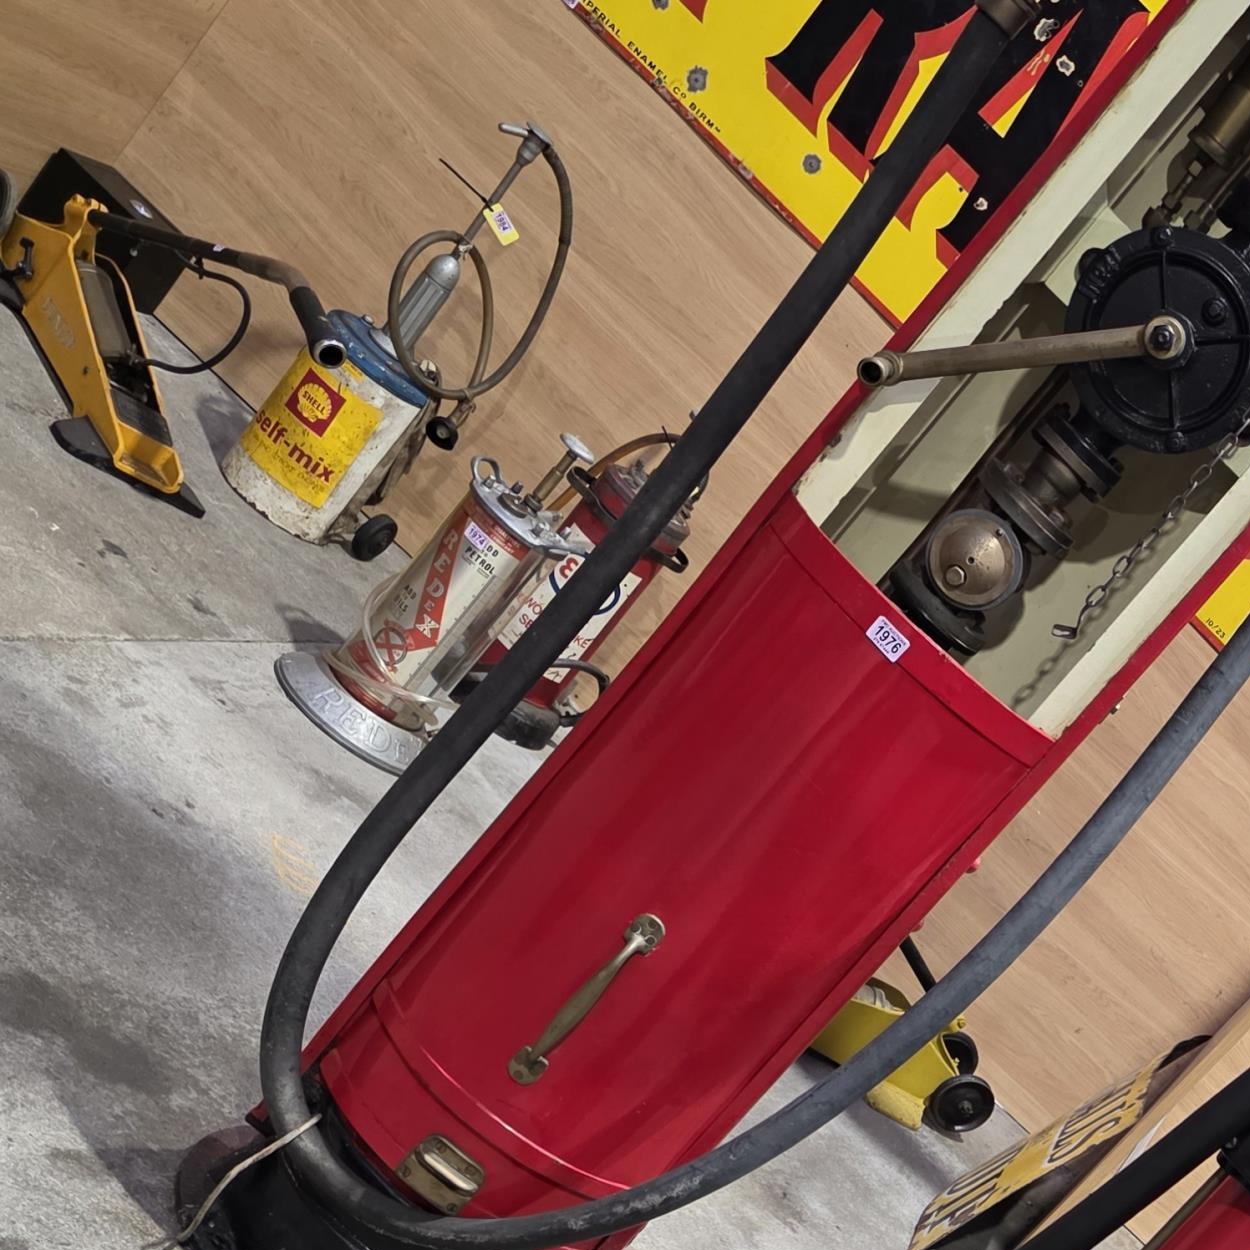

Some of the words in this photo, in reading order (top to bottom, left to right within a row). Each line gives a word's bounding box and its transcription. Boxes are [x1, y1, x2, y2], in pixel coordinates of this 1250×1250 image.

[302, 390, 327, 415] SHELL
[256, 409, 335, 484] self-mix
[468, 527, 486, 546] 1974
[465, 546, 496, 575] PETROL
[875, 625, 902, 654] 1976
[313, 687, 422, 764] REDE
